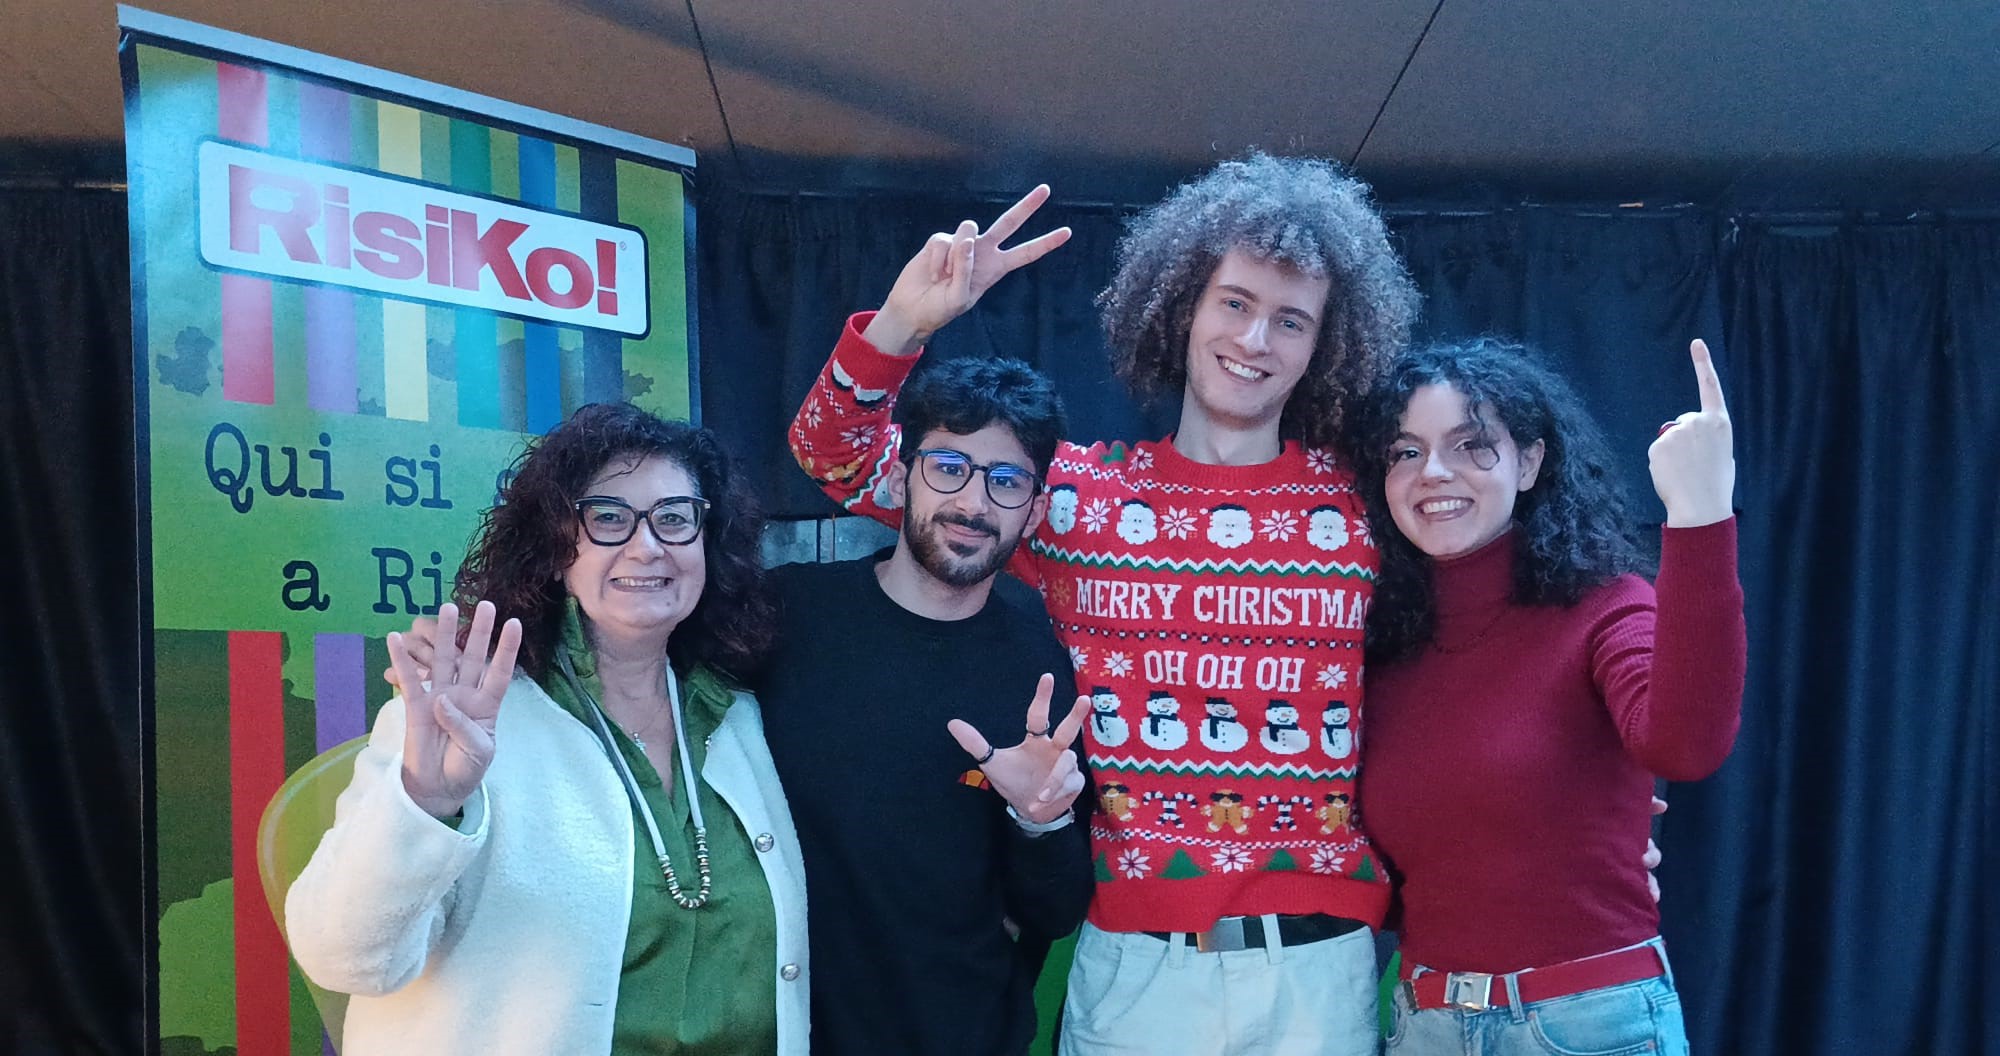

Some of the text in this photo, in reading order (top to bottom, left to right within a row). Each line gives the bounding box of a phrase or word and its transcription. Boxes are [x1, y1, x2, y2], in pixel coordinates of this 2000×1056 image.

[228, 163, 619, 316] RisiKo!
[205, 422, 344, 513] Qui
[385, 445, 453, 509] si
[281, 547, 443, 616] a Ri
[1075, 577, 1371, 630] MERRY CHRISTMA
[1143, 650, 1305, 692] OH OH OH
